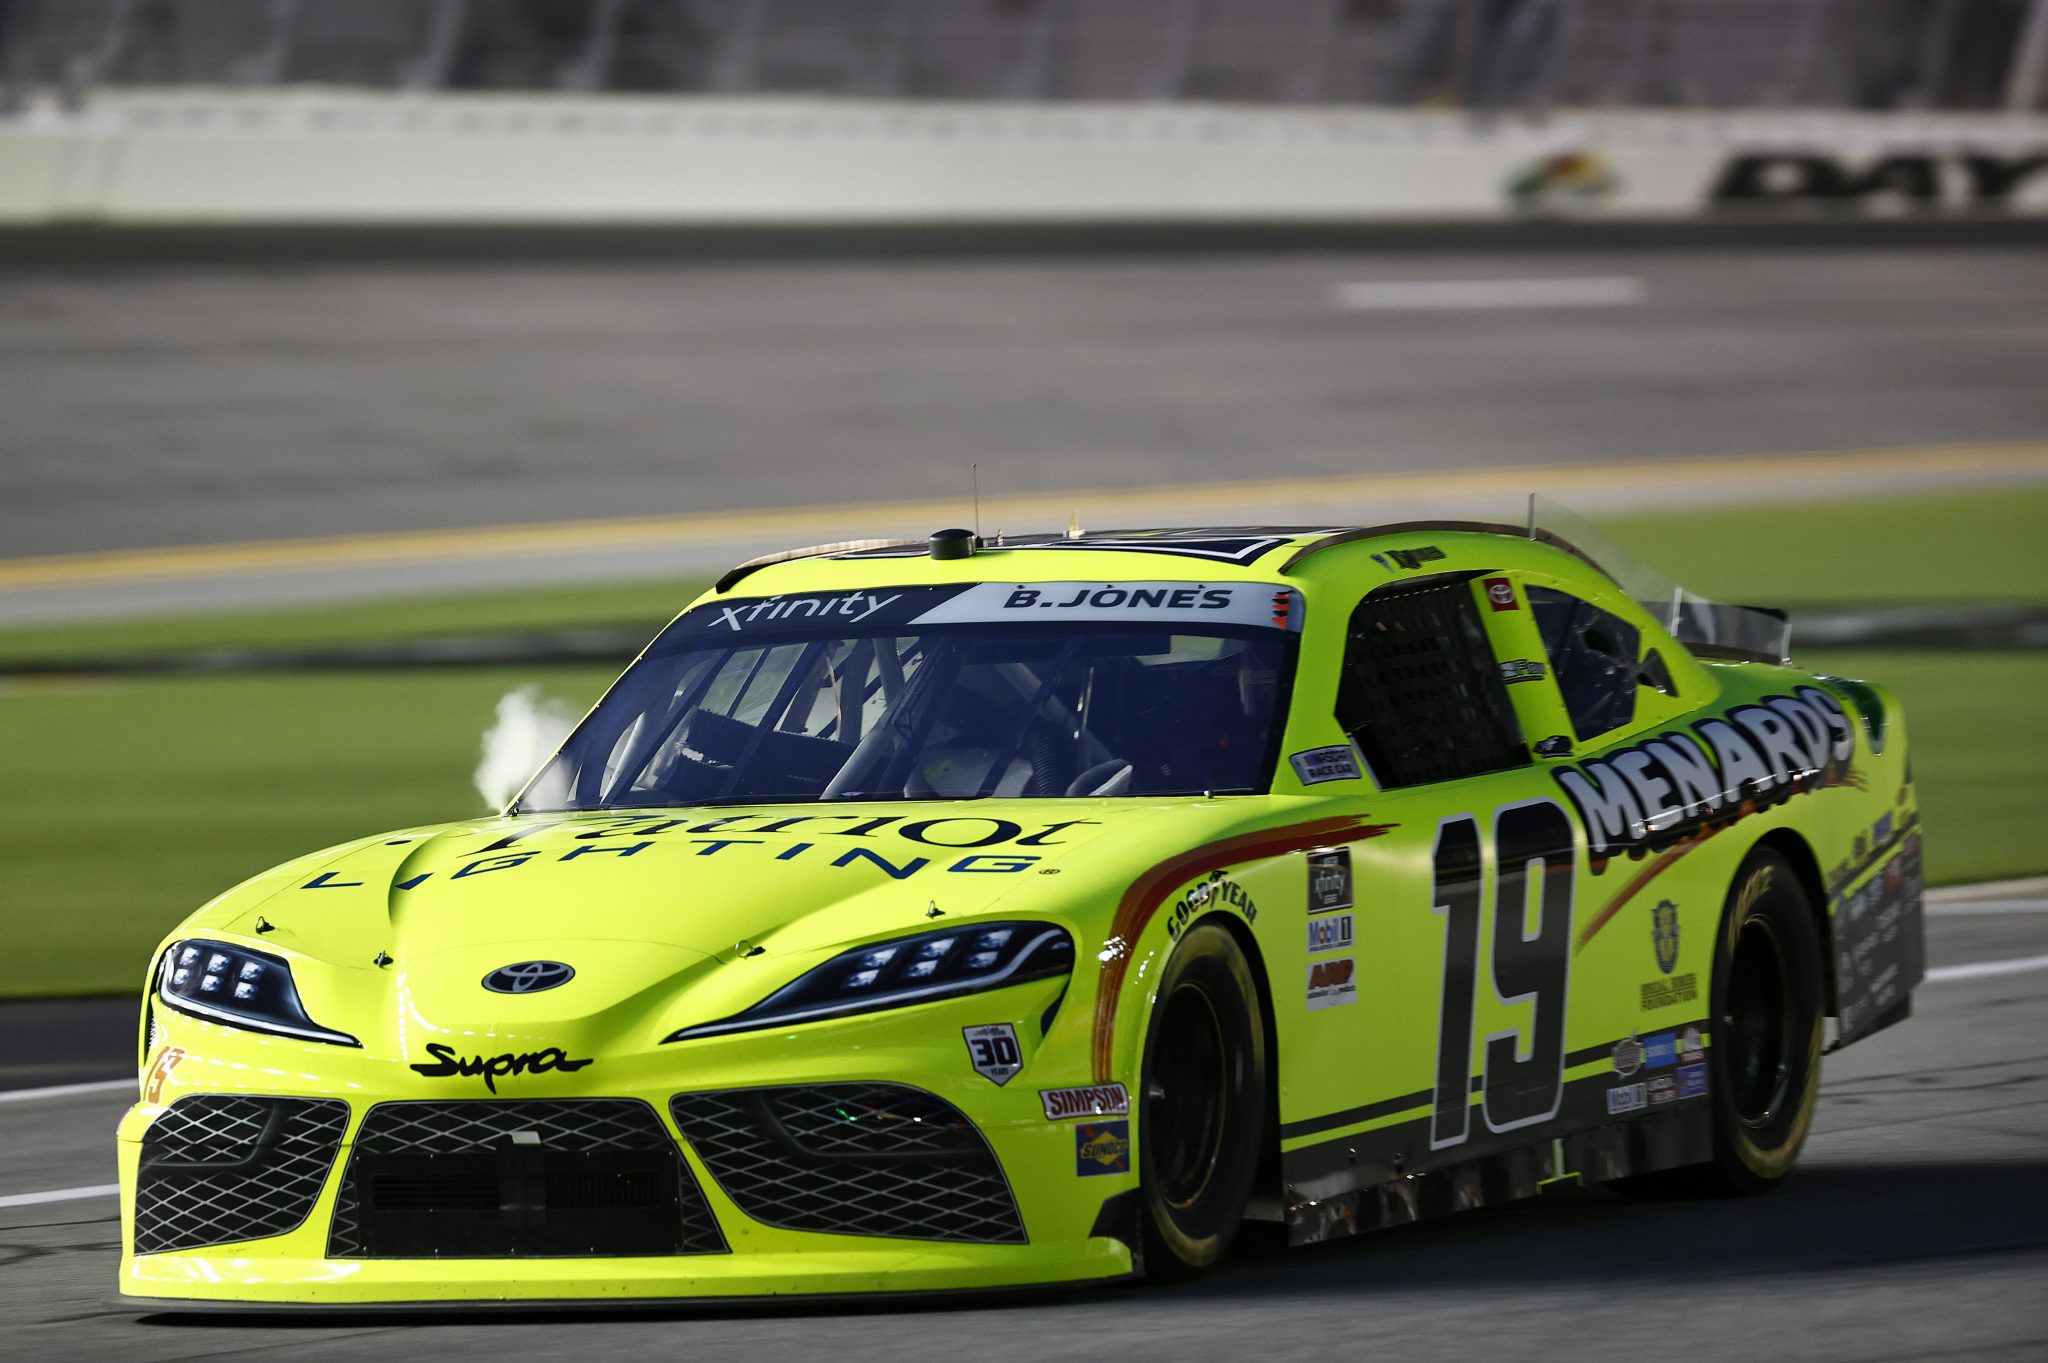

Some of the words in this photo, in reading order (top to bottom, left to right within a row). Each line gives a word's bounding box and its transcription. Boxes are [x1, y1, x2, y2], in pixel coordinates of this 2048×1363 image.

[707, 594, 903, 632] xfinity
[1308, 765, 1335, 778] RACE
[1335, 763, 1352, 774] CAR
[1558, 688, 1853, 854] MENARDS
[300, 839, 1042, 890] LIGHTING
[1309, 917, 1339, 946] Mobil
[1341, 915, 1352, 941] 1
[1309, 959, 1354, 990] ARP
[1430, 797, 1575, 1150] 19
[970, 1036, 1018, 1067] 30
[410, 1043, 594, 1095] Supra
[1047, 1086, 1125, 1116] SIMPSON
[1081, 1139, 1129, 1159] SUNOCO
